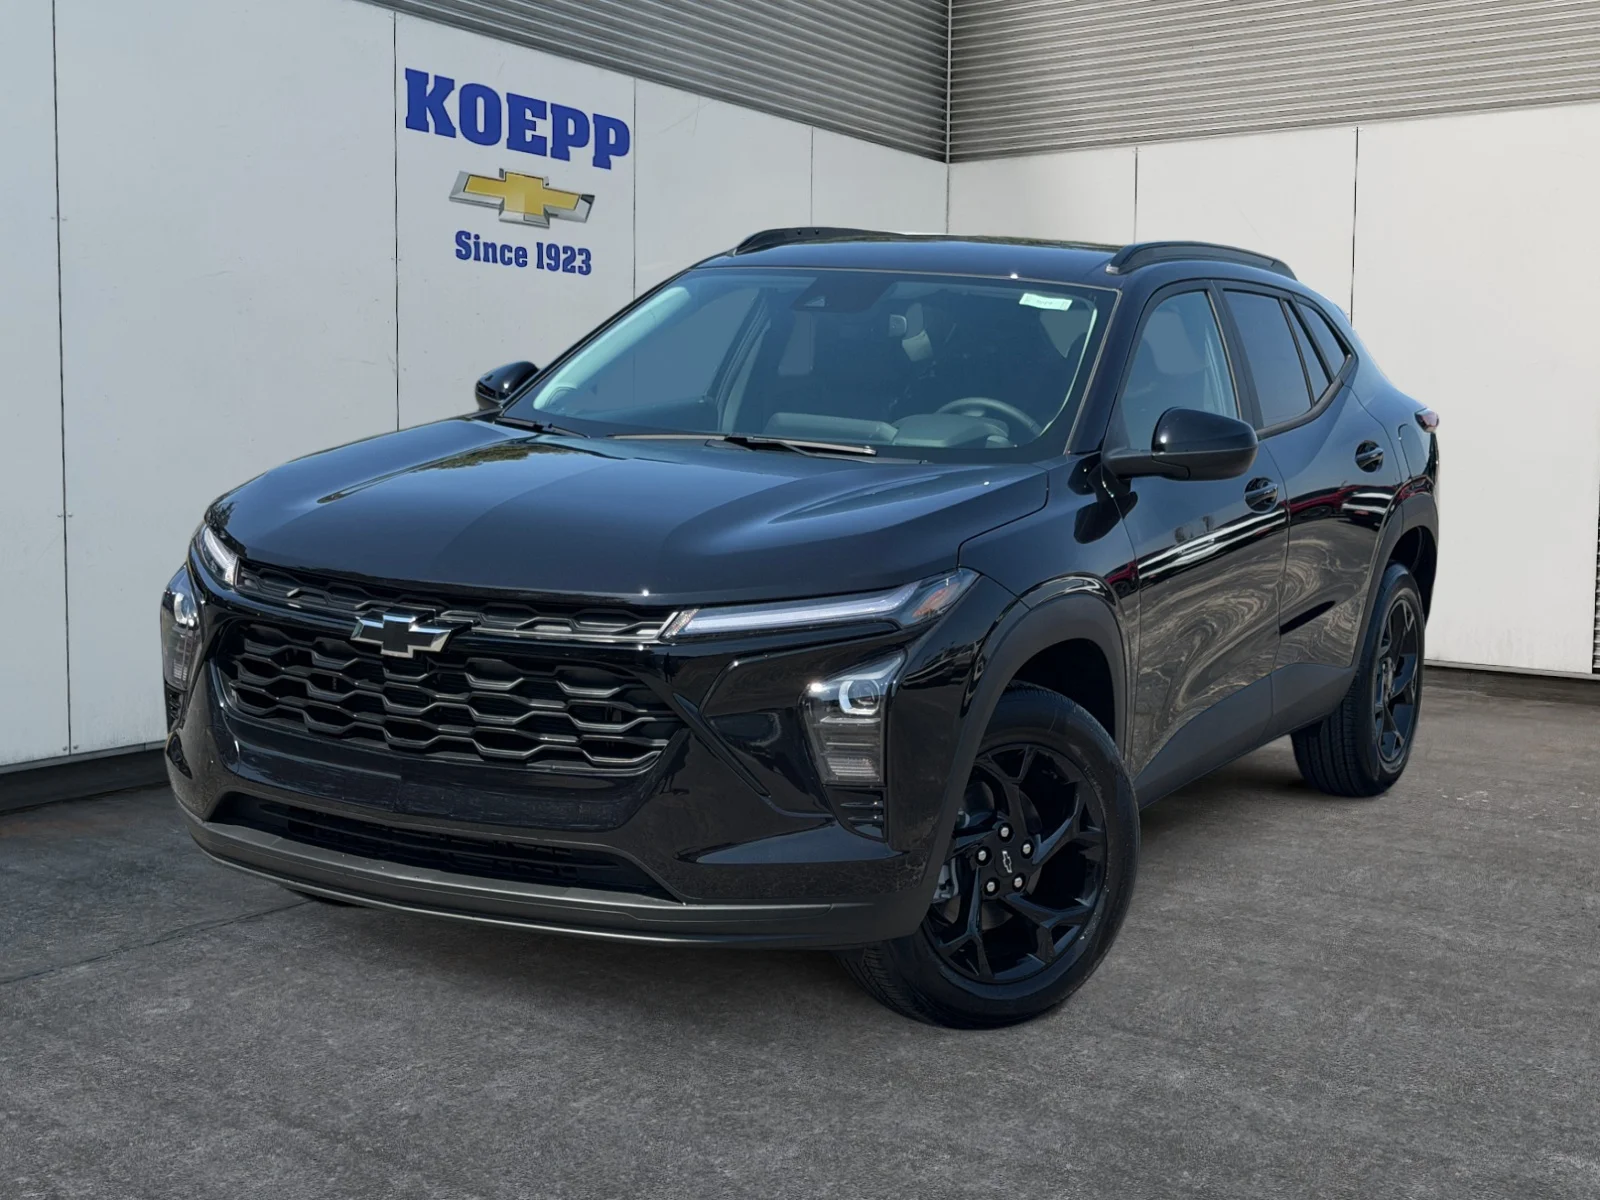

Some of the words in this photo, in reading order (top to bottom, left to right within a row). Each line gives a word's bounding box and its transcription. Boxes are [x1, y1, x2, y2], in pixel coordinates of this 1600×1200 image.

[405, 67, 631, 170] KOEPP
[455, 230, 528, 269] Since
[536, 242, 592, 276] 1923
